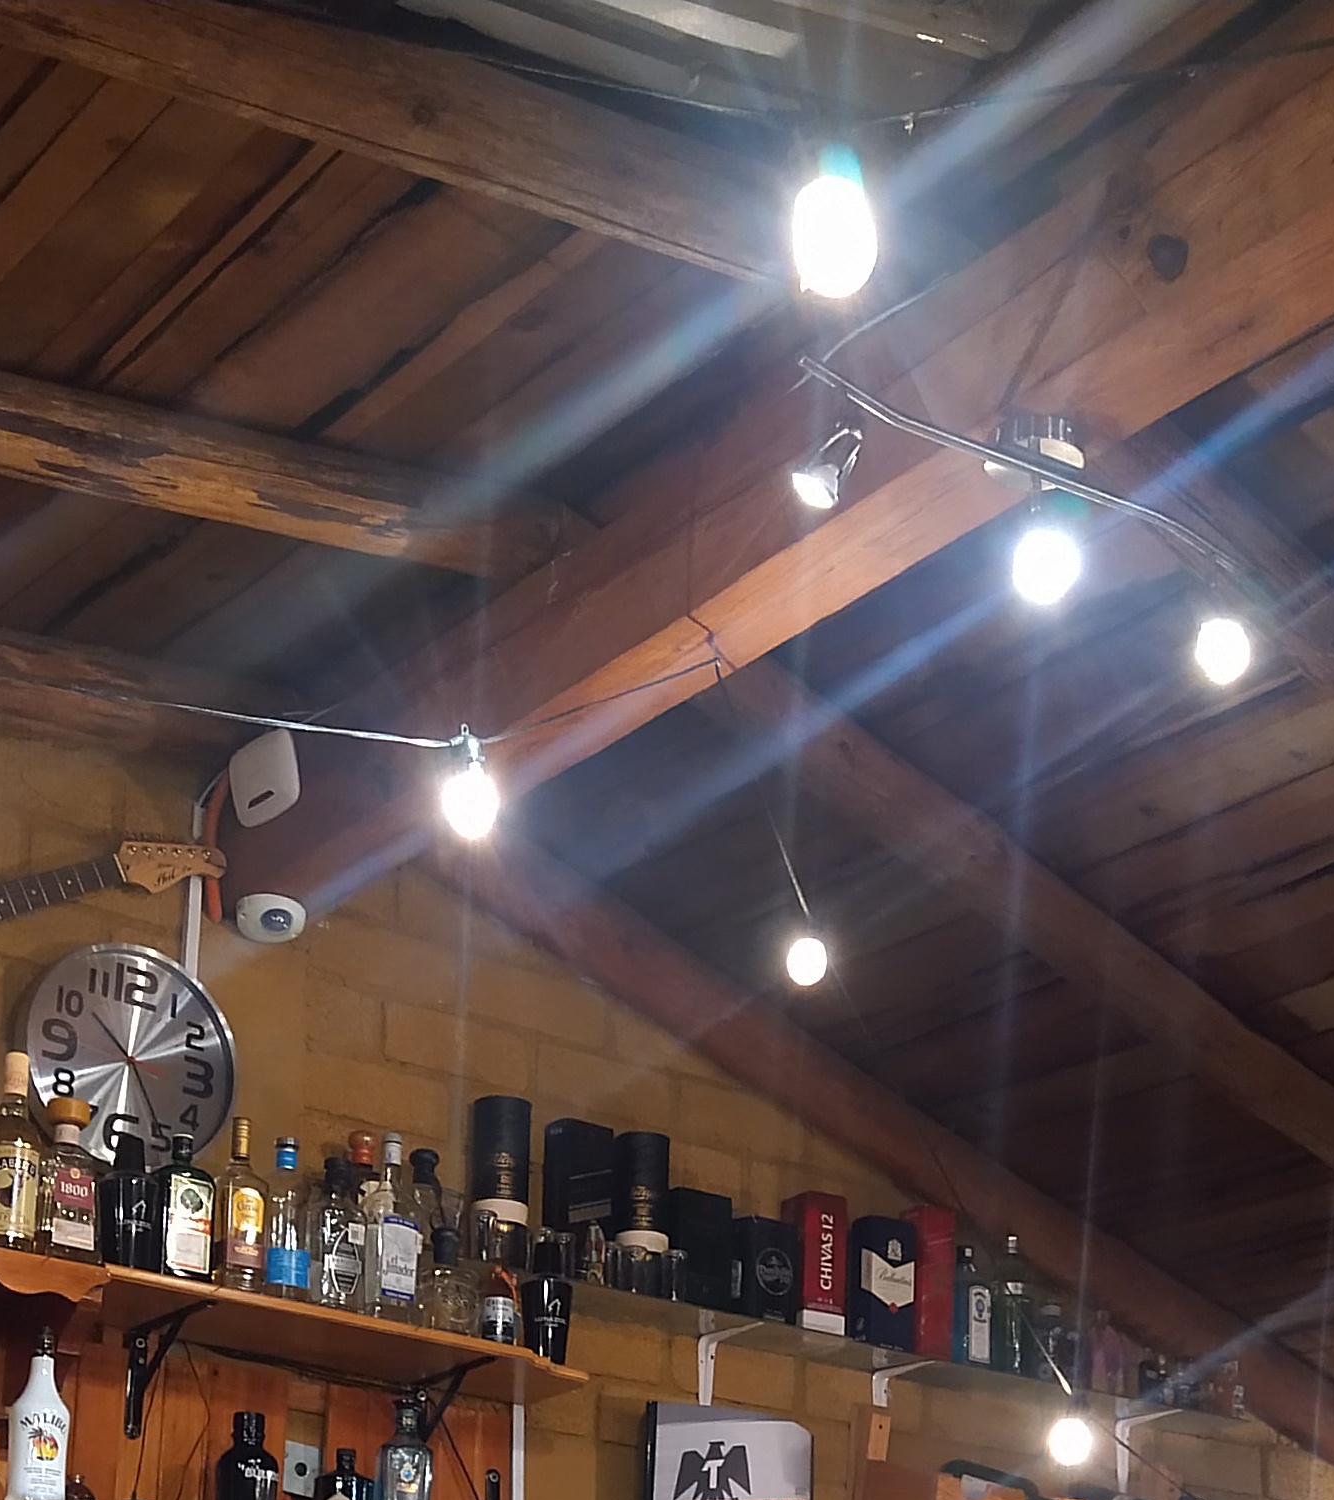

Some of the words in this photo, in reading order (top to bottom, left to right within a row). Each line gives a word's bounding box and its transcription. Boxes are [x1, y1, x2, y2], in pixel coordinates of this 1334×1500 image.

[88, 967, 110, 998] 11
[170, 992, 178, 1019] 1
[115, 962, 159, 1013] 12
[56, 985, 85, 1018] 10
[184, 1020, 206, 1051] 2
[41, 1017, 79, 1062] 9
[181, 1055, 214, 1100] 3
[52, 1066, 75, 1098] 8
[179, 1103, 200, 1132] 4
[60, 1181, 89, 1198] 1800
[821, 1213, 835, 1230] 12
[819, 1232, 834, 1291] CHIVAS
[19, 1412, 68, 1435] MALIBU
